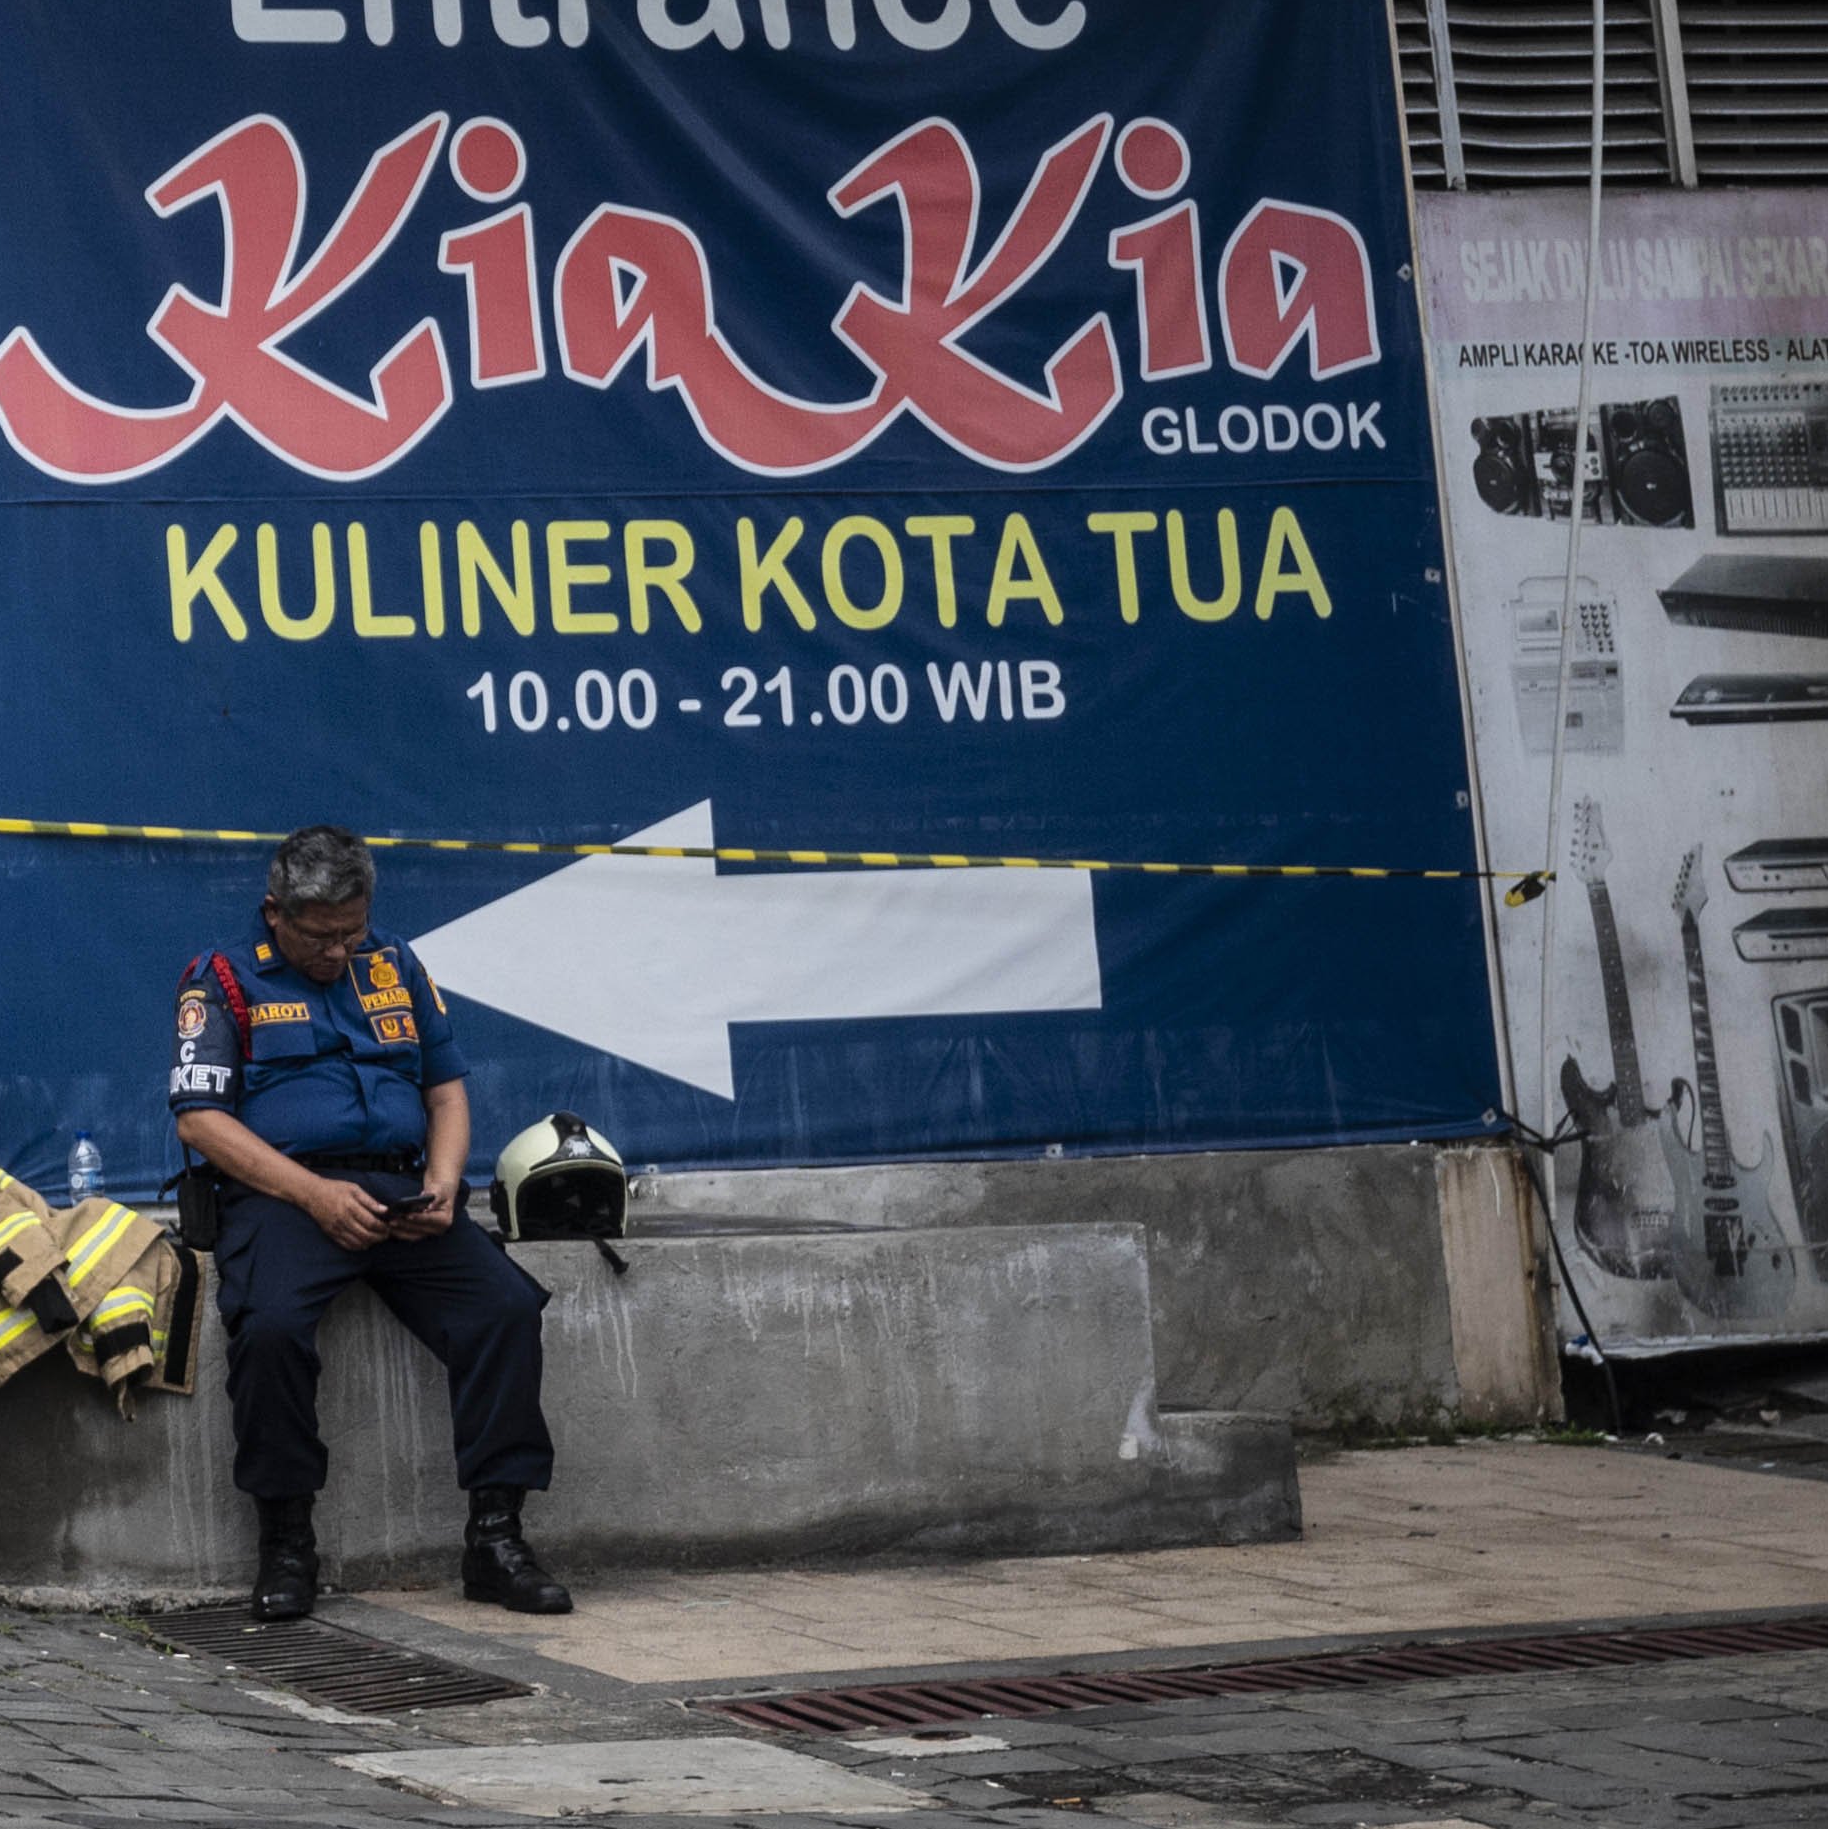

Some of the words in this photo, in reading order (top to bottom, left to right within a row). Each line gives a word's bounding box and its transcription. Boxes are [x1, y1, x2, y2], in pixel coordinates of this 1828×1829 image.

[735, 110, 1383, 480] Kia
[1459, 239, 1556, 304] SEJAK
[1635, 236, 1737, 300] SAMPAI
[1459, 344, 1520, 368] AMPLI
[1673, 339, 1771, 364] WIRELESS
[1140, 401, 1387, 456] GLODOK
[165, 517, 704, 645] KULINER
[735, 511, 1067, 634] KOTA
[1086, 506, 1335, 624] TUA
[465, 671, 660, 735] 10.00
[720, 661, 911, 731] 21.00
[925, 659, 1069, 726] WIB
[180, 1041, 196, 1064] C
